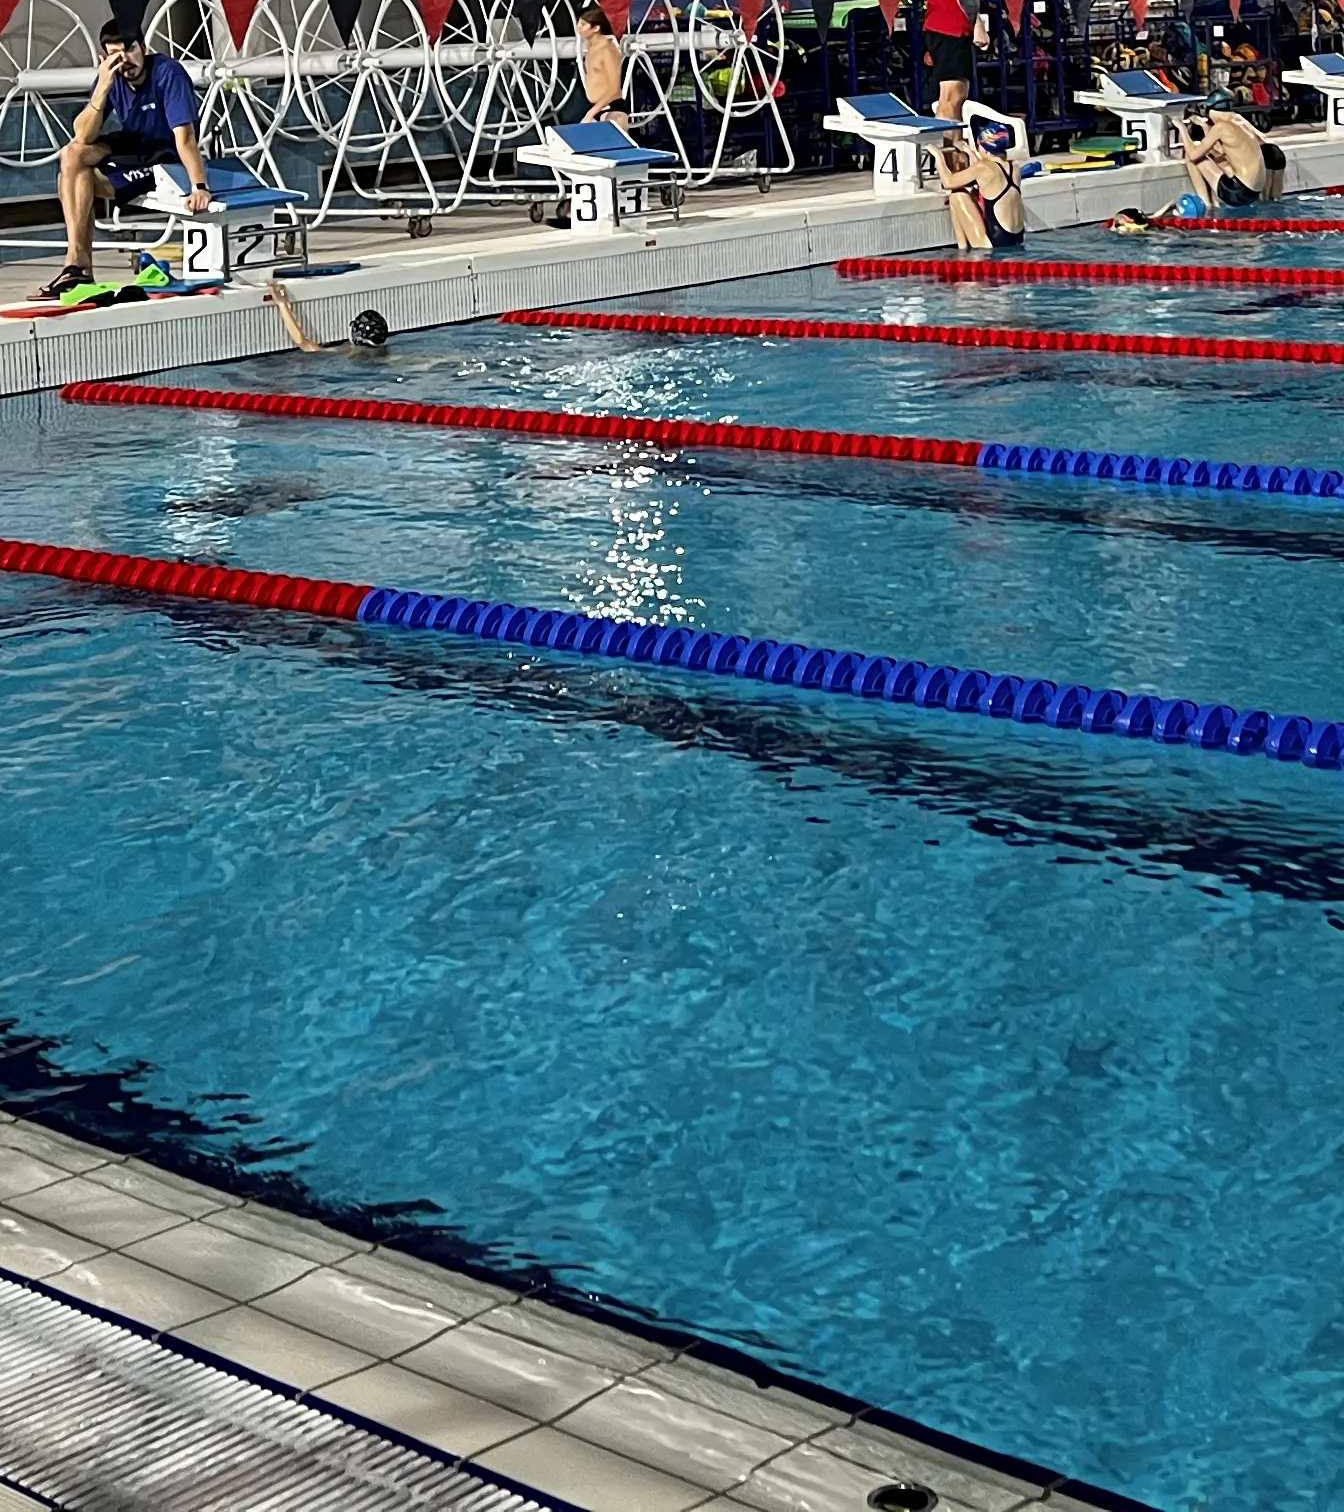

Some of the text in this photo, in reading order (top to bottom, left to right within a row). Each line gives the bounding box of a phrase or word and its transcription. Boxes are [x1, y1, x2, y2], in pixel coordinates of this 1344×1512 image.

[1126, 120, 1147, 151] 5
[880, 148, 899, 182] 4
[575, 183, 597, 221] 3
[187, 228, 209, 273] 2
